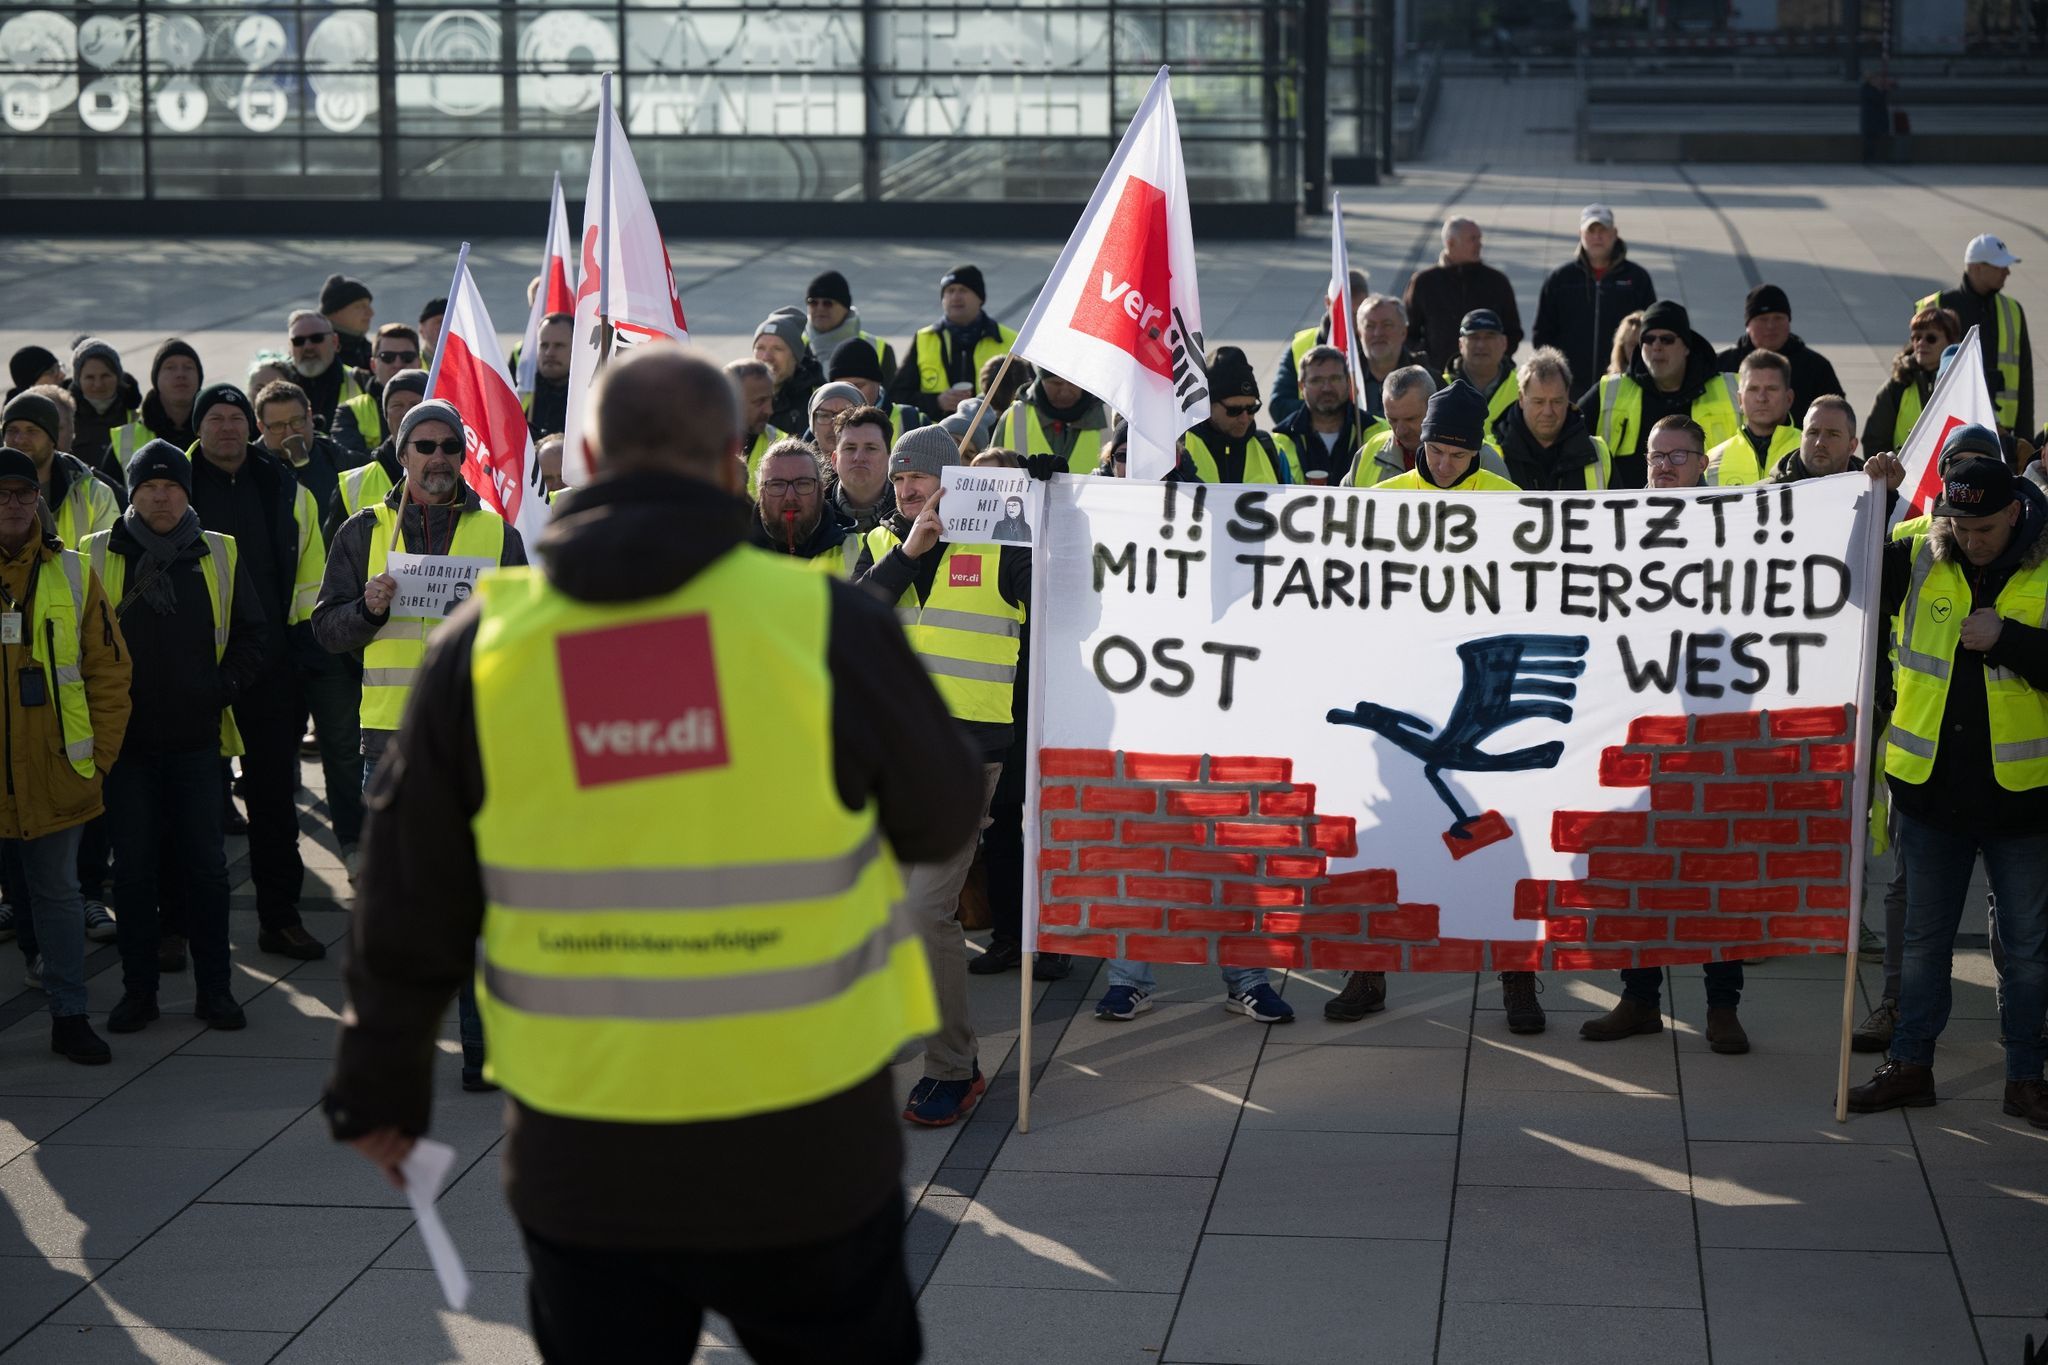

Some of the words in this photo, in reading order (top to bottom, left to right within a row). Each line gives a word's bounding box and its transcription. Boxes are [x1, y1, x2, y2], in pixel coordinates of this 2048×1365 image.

[955, 478, 1033, 493] SOLIDARITÄT
[977, 499, 999, 512] MIT
[948, 518, 988, 531] SIBEL!
[1159, 480, 1207, 541] !!
[1513, 485, 1795, 554] JETZT!!
[402, 563, 480, 579] SOLIDARITÄT
[951, 573, 979, 583] ver.di
[427, 582, 448, 594] MIT
[1092, 541, 1207, 599] MIT
[1235, 554, 1852, 622] TARIFUNTERSCHIED
[399, 595, 438, 608] SIBEL!
[1092, 635, 1262, 711] OST
[1616, 629, 1827, 698] WEST
[577, 707, 716, 755] ver.di
